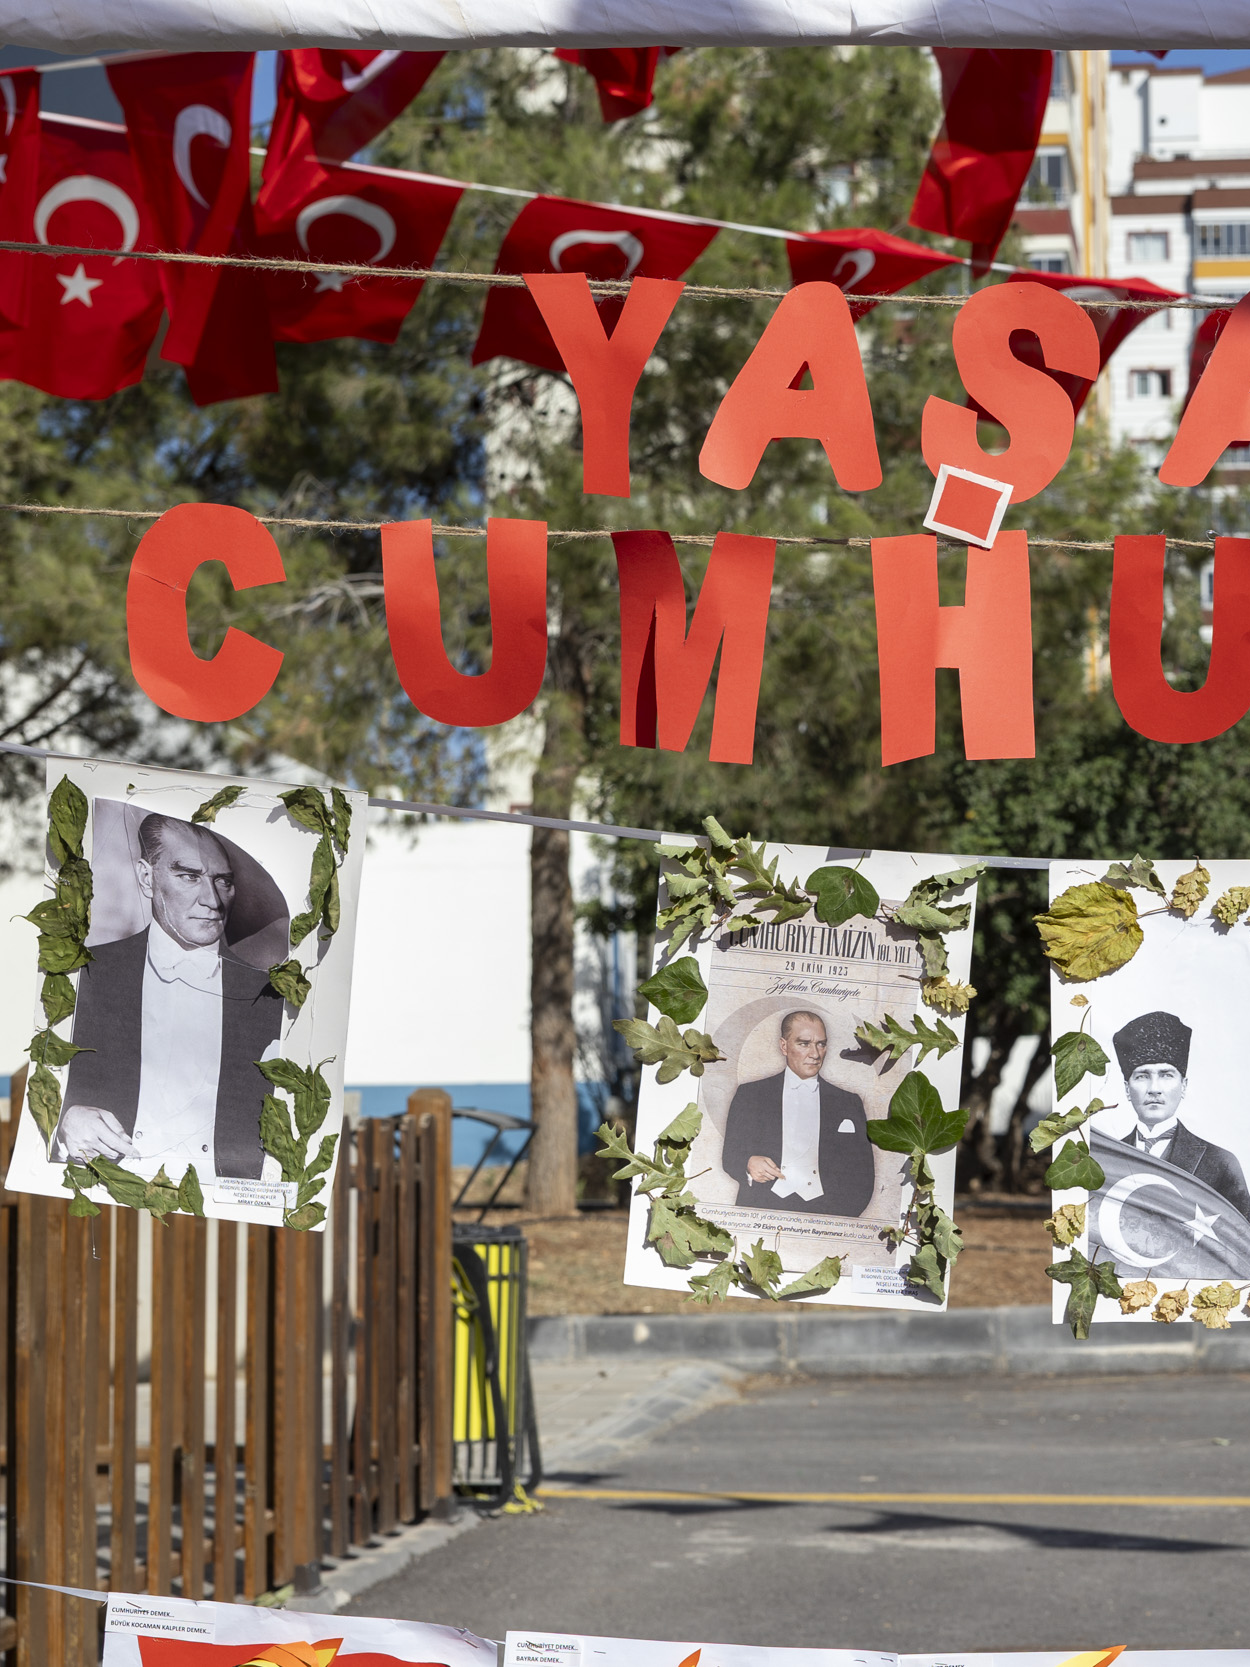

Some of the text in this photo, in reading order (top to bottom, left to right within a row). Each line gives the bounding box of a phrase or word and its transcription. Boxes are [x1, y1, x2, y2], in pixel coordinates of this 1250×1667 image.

[877, 944, 893, 962] 101.
[894, 946, 911, 964] YILI
[785, 960, 849, 977] 29 EKİM 1923
[777, 1225, 811, 1235] Cumhuriyet
[111, 1607, 149, 1615] CUMHURİYET
[131, 1621, 161, 1630] KOCAMAN
[162, 1624, 186, 1632] KALPLER
